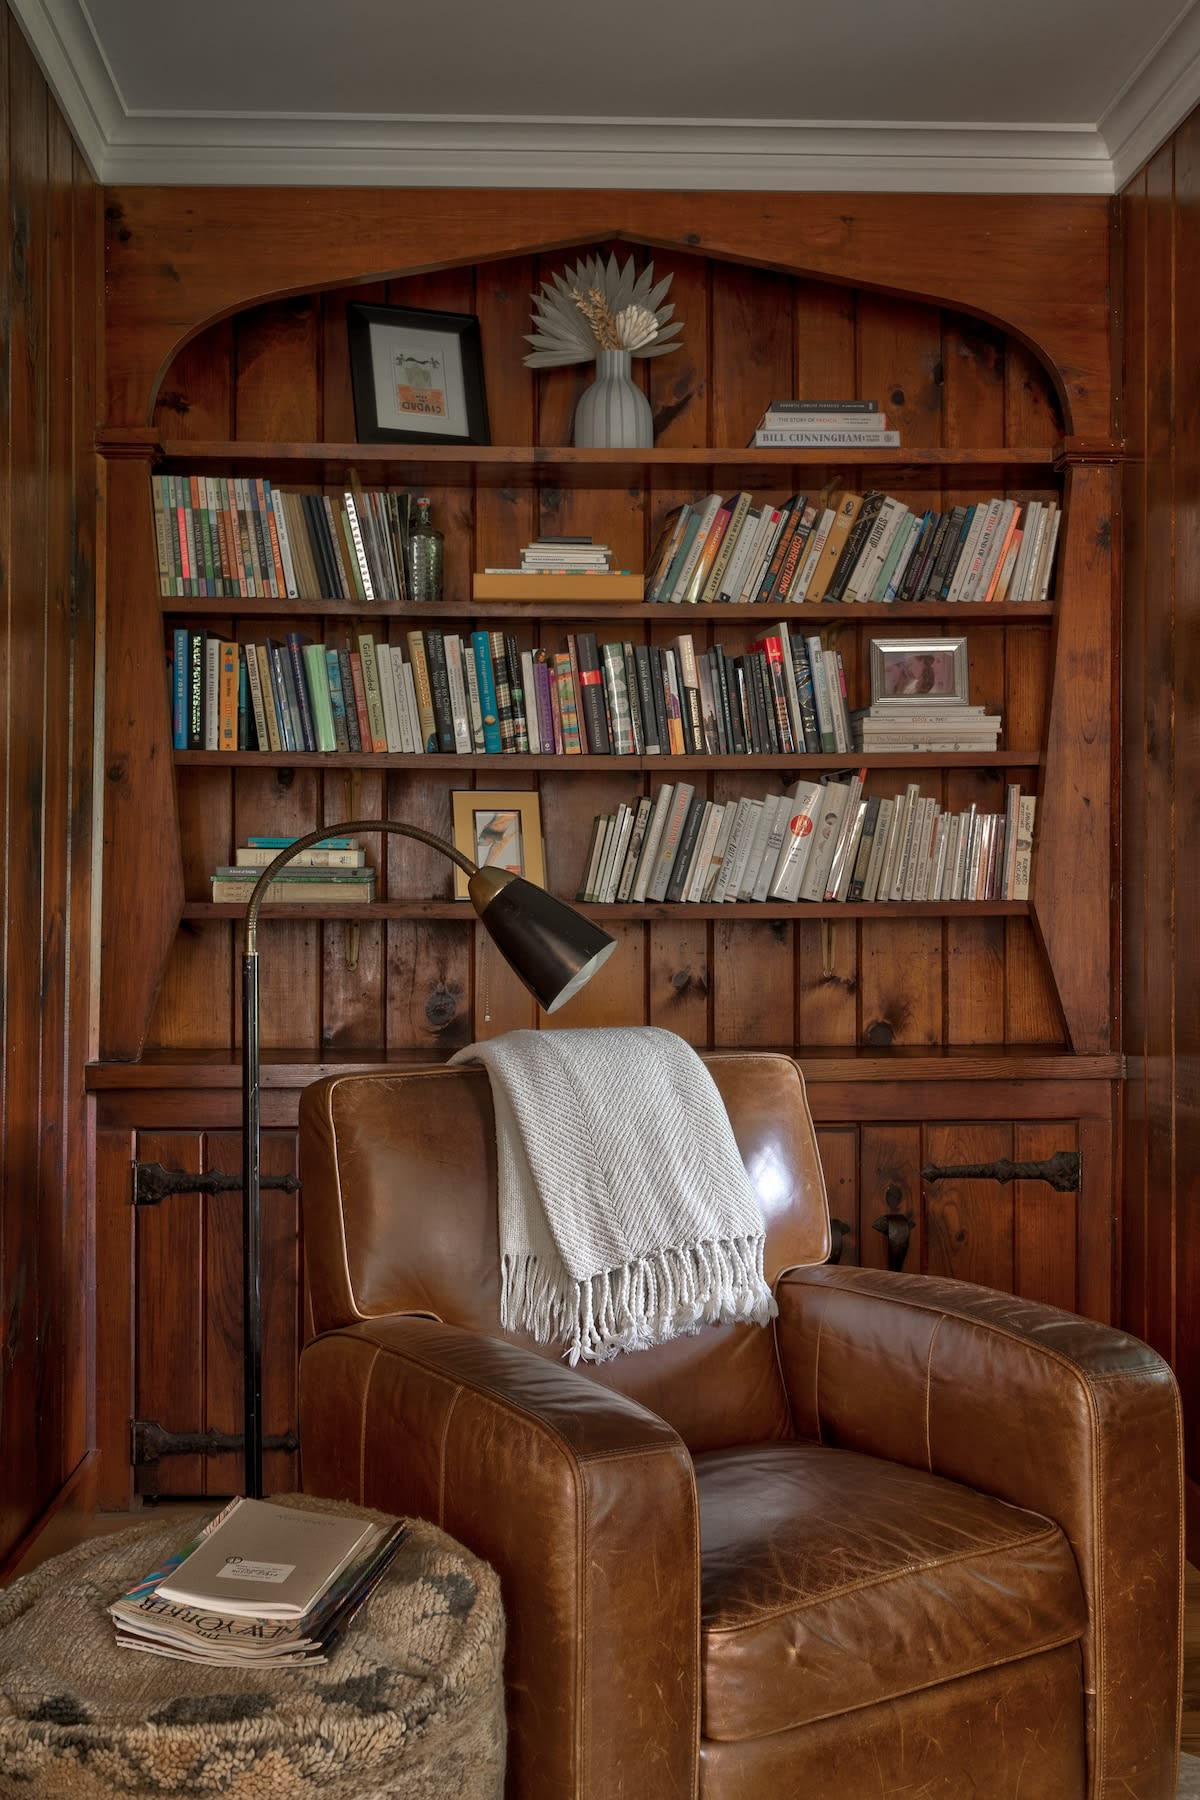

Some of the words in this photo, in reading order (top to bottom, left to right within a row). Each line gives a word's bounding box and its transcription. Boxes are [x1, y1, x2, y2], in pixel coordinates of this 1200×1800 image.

[763, 434, 786, 442] BILL
[867, 516, 888, 549] STARTUP
[777, 535, 802, 595] CORRECTIONS
[362, 642, 371, 657] Girl
[364, 659, 375, 691] Decoded
[638, 658, 648, 677] david
[431, 670, 440, 687] Your
[438, 670, 446, 687] How
[434, 689, 442, 708] Mind
[440, 688, 447, 696] to
[140, 1597, 233, 1634] YORKER
